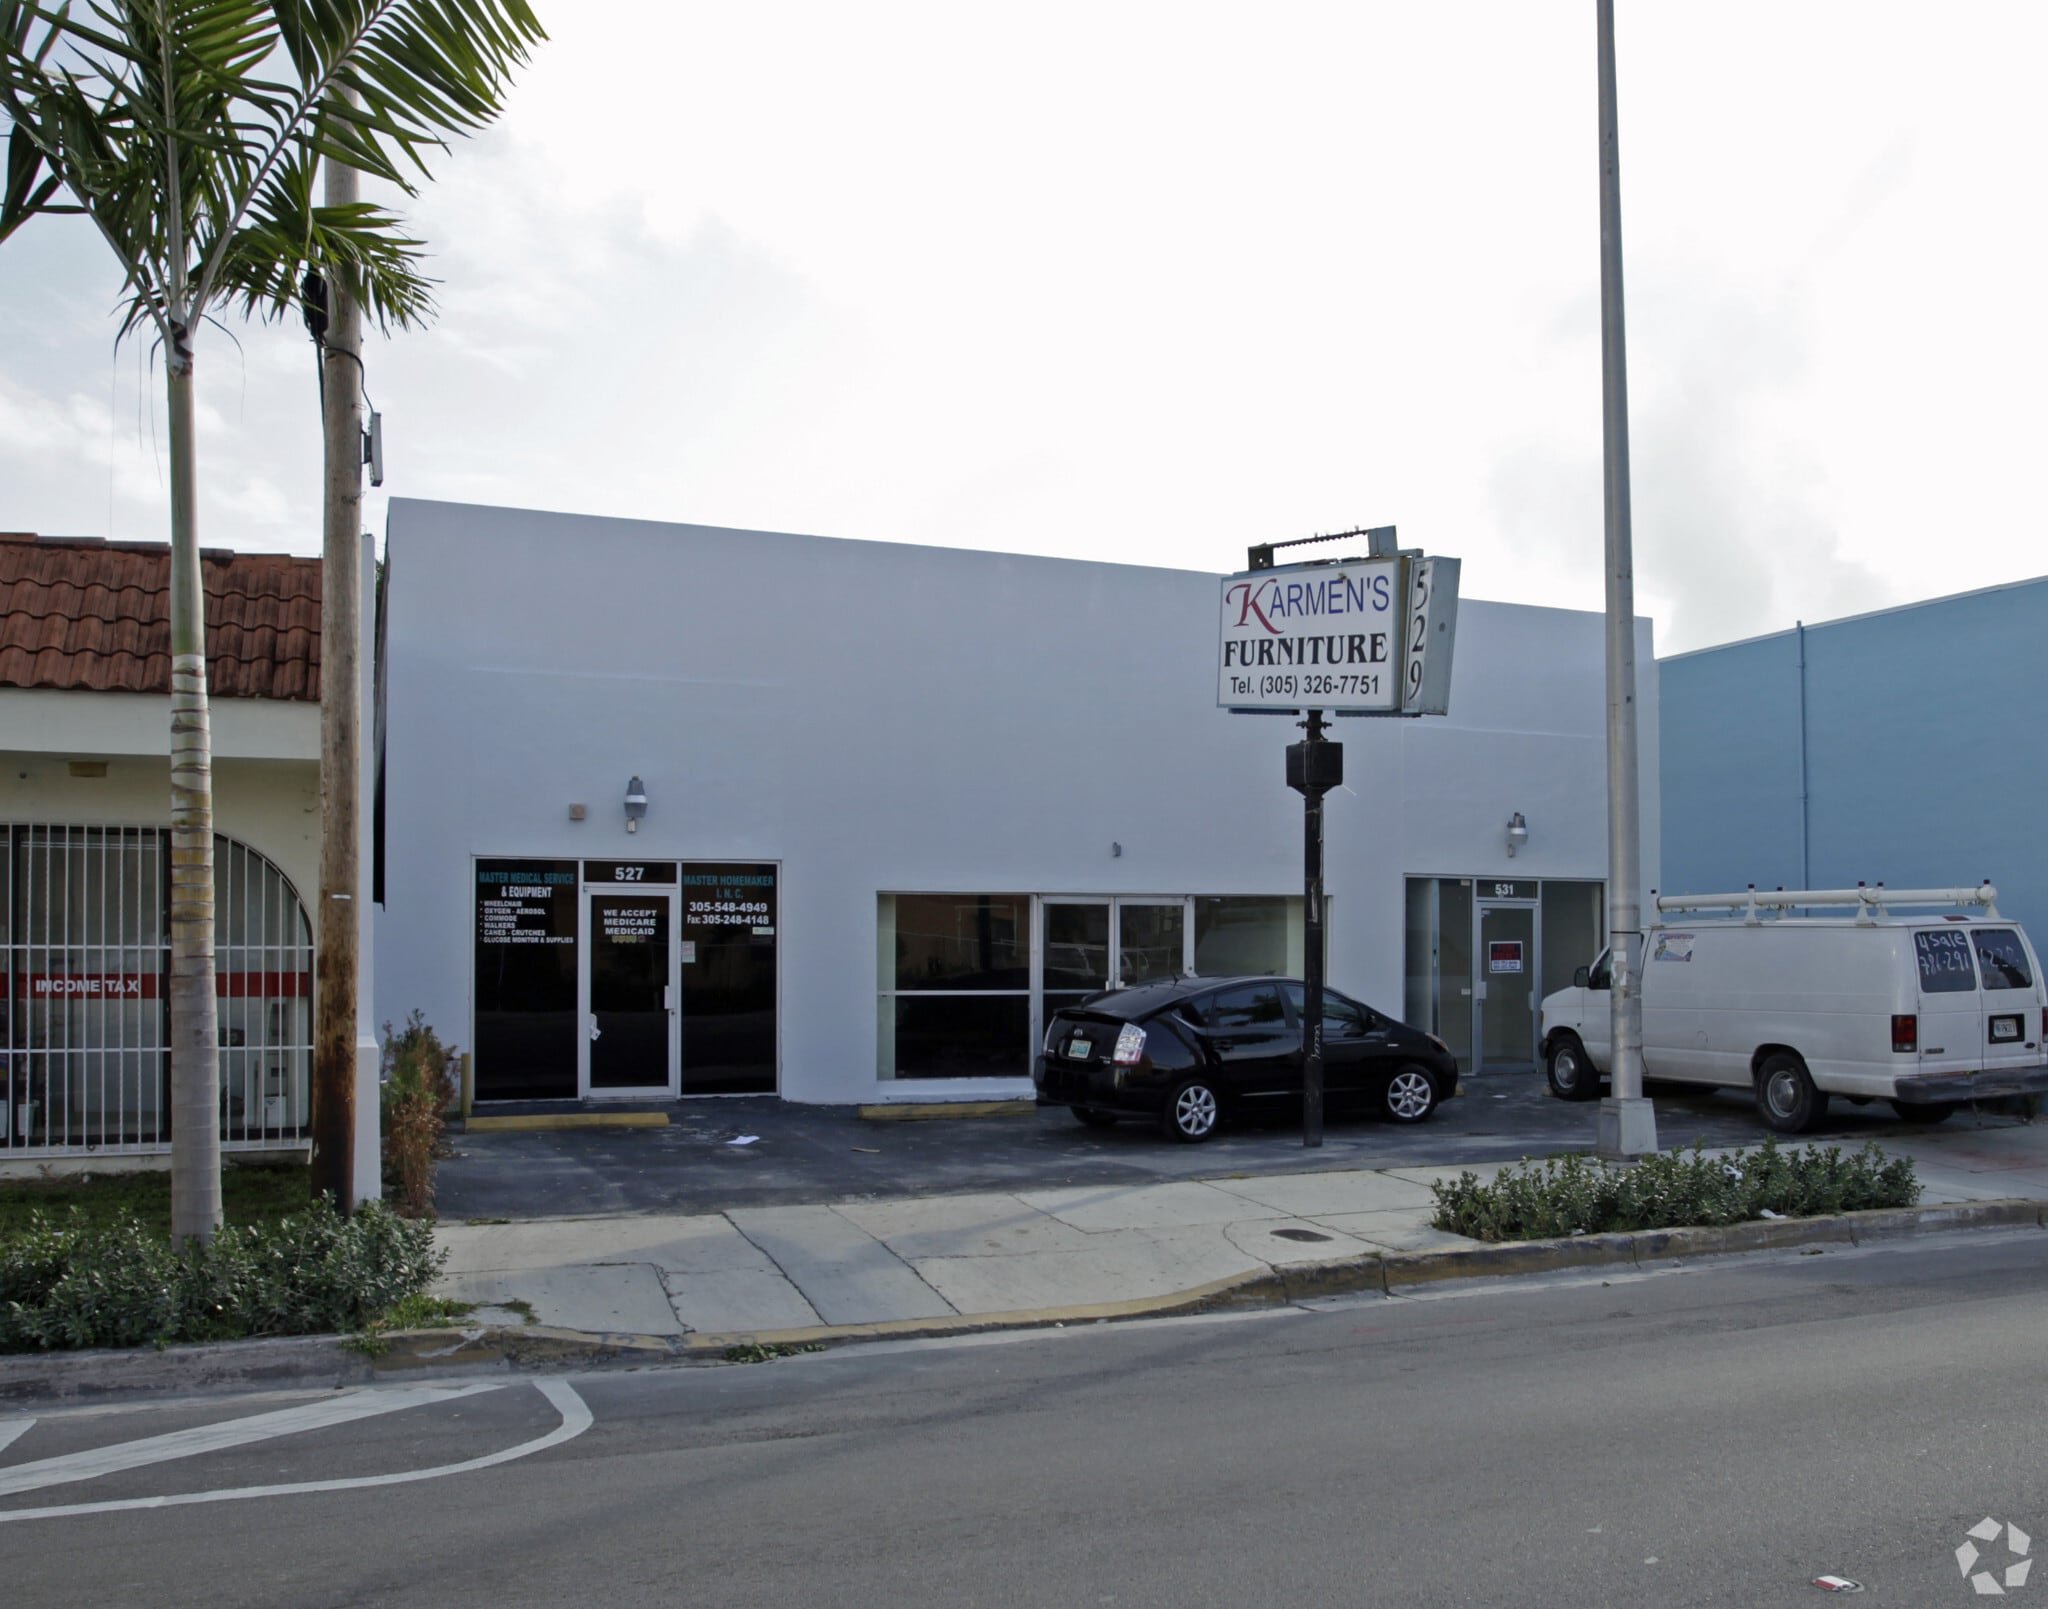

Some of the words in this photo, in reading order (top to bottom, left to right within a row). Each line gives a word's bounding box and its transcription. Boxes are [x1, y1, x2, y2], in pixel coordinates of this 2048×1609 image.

[1225, 575, 1390, 635] KARMEN'S
[1408, 569, 1430, 701] 529
[1223, 633, 1389, 668] FURNITURE
[1230, 676, 1255, 695] Tel.
[1260, 675, 1298, 698] (305)
[1303, 675, 1379, 695] 326-7751
[479, 872, 509, 883] MASTER
[510, 872, 542, 884] MEDICAL
[543, 873, 575, 884] SERVICE
[615, 866, 645, 881] 527
[683, 875, 718, 886] MASTER
[720, 876, 774, 887] HOMEMAKER
[501, 886, 507, 897] &
[508, 886, 552, 898] EQUIPMENT
[1495, 883, 1514, 895] 531
[689, 901, 768, 912] 305-548-4949
[603, 909, 618, 917] WE
[620, 909, 657, 917] ACCEPT
[603, 918, 656, 926] MEDICARE
[511, 929, 546, 937] CRUTCHES
[605, 927, 655, 935] MEDICAID
[36, 979, 101, 993] INCOME
[105, 979, 139, 993] TAX
